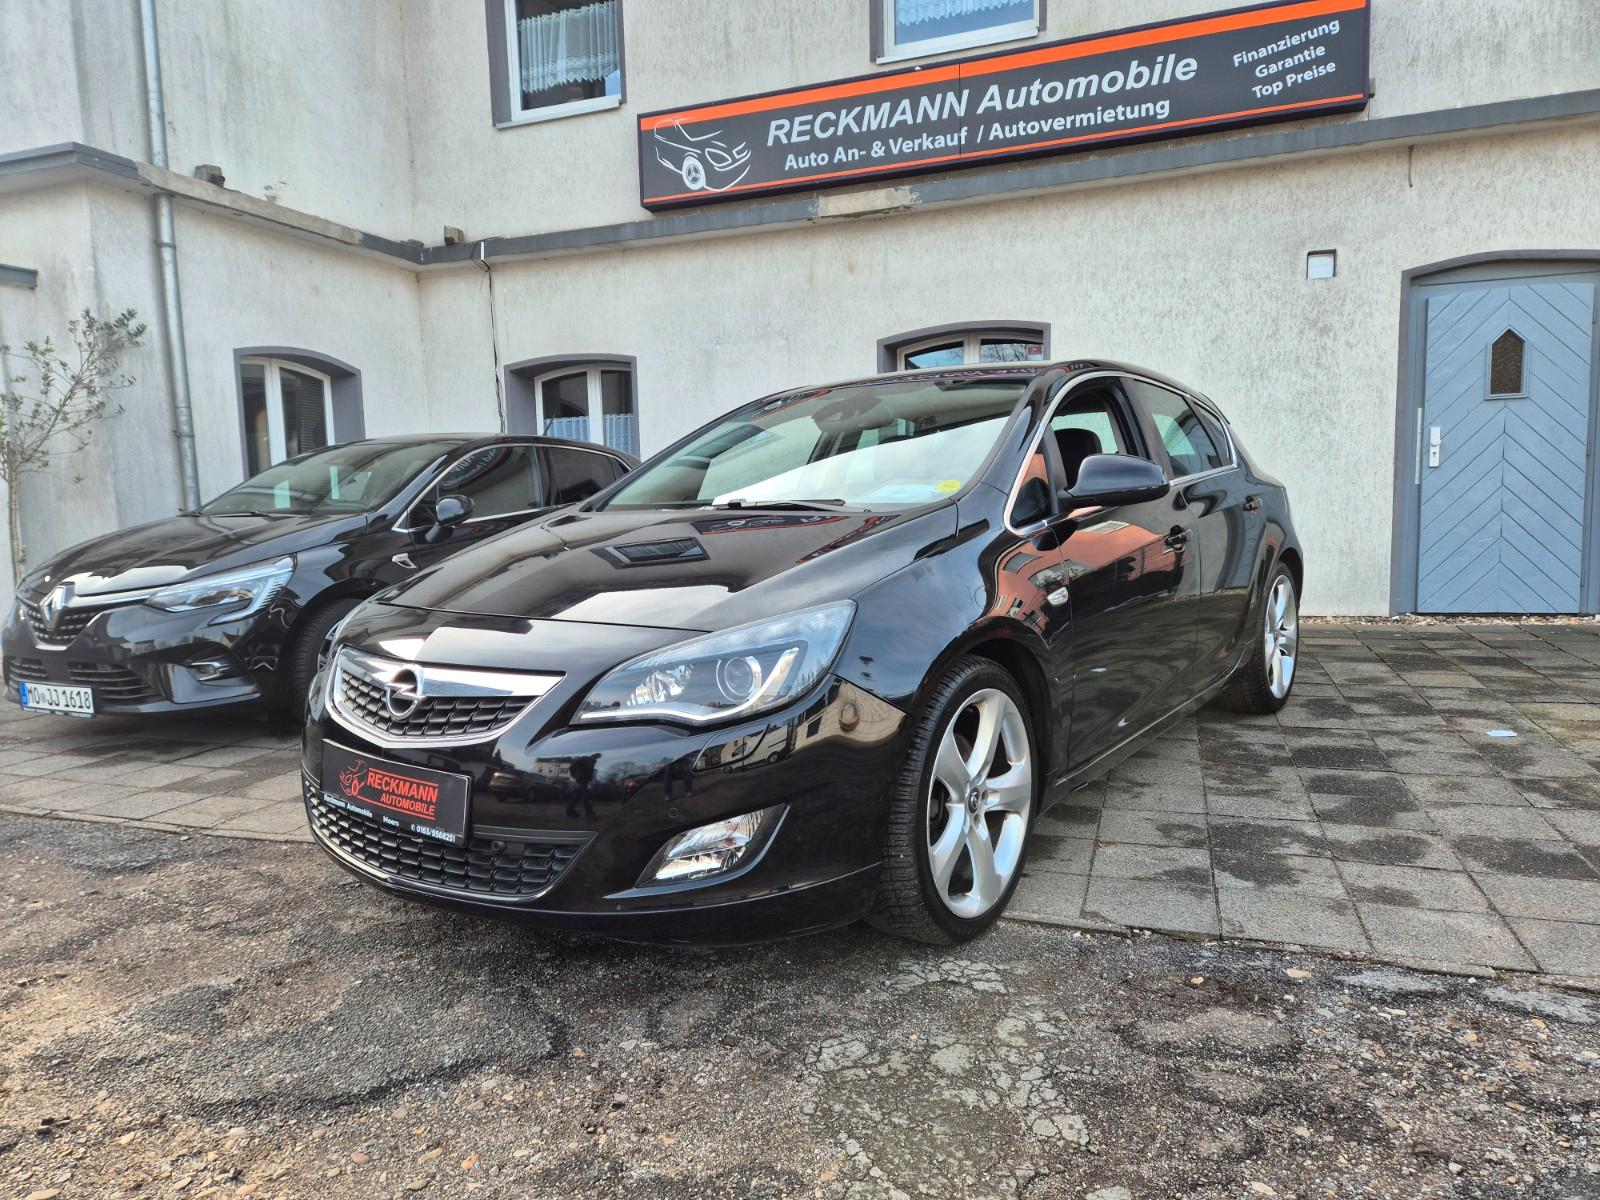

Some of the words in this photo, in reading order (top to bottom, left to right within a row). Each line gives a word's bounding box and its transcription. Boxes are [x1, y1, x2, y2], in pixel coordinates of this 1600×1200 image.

[1232, 19, 1340, 67] Finanzierung
[1255, 45, 1326, 77] Garantie
[1251, 81, 1283, 98] Top
[1286, 62, 1336, 87] Preise
[767, 89, 970, 147] RECKMANN
[976, 53, 1198, 115] Automobile
[784, 153, 829, 171] Auto
[833, 146, 866, 163] An-
[871, 140, 886, 158] &
[889, 127, 968, 155] Verkauf
[988, 99, 1170, 141] Autovermietung
[367, 771, 439, 803] RECKMANN
[380, 793, 436, 815] AUTOMOBILE
[346, 802, 373, 818] Automobile
[382, 815, 400, 827] Moers
